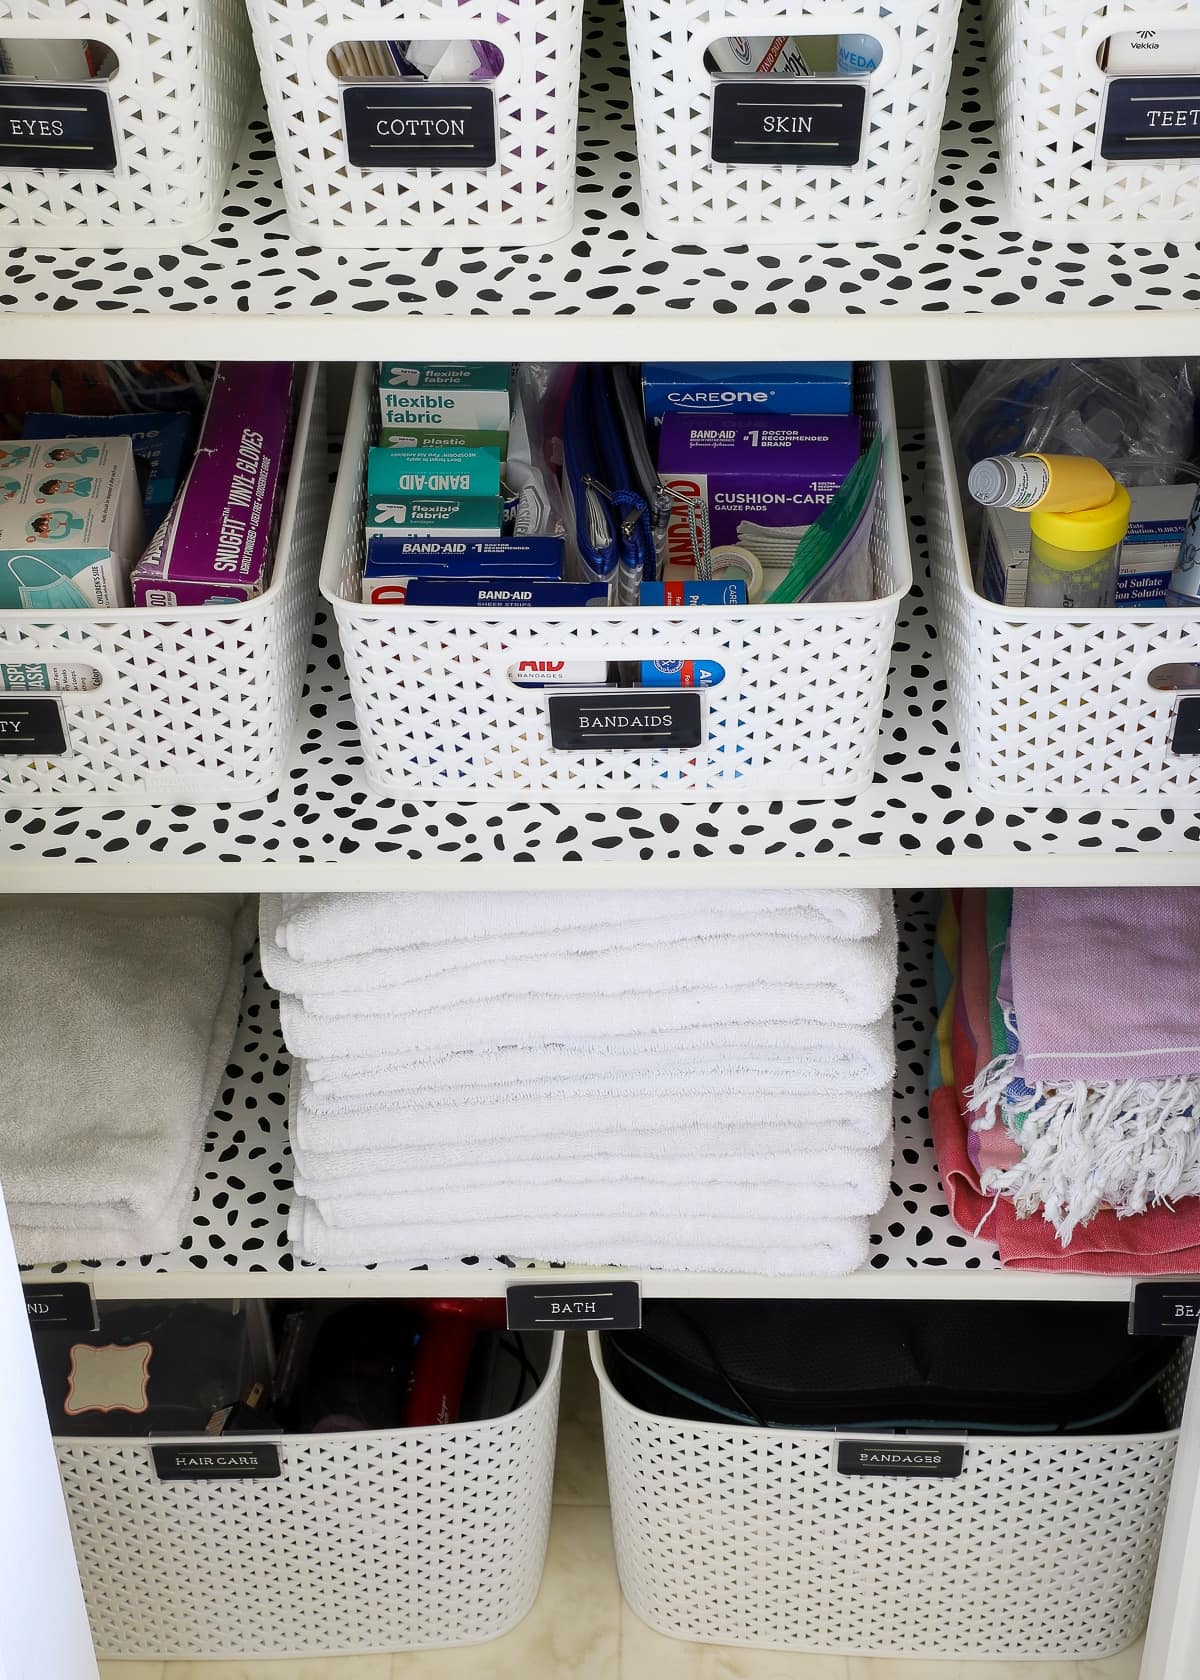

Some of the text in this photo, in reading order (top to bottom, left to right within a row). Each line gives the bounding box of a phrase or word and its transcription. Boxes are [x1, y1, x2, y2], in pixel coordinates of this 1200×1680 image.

[10, 120, 64, 137] EYES
[376, 119, 465, 136] COTTON
[763, 116, 813, 133] SKIN
[385, 394, 455, 408] flexible
[386, 410, 442, 424] fabric
[690, 430, 736, 438] BAND-AID
[743, 430, 759, 447] #1
[236, 428, 264, 475] GLOVES
[399, 474, 471, 490] BAND-AID
[228, 474, 256, 508] VINYL
[714, 493, 835, 504] CUSHION-CARE
[402, 543, 466, 553] BAND-AID
[1130, 579, 1163, 588] Sulfate
[478, 590, 533, 600] BAND-AID
[579, 715, 673, 728] BANDAIDS
[551, 1302, 597, 1313] BATH
[176, 1457, 258, 1465] HAIR CARE
[859, 1453, 942, 1463] BANDAGES
